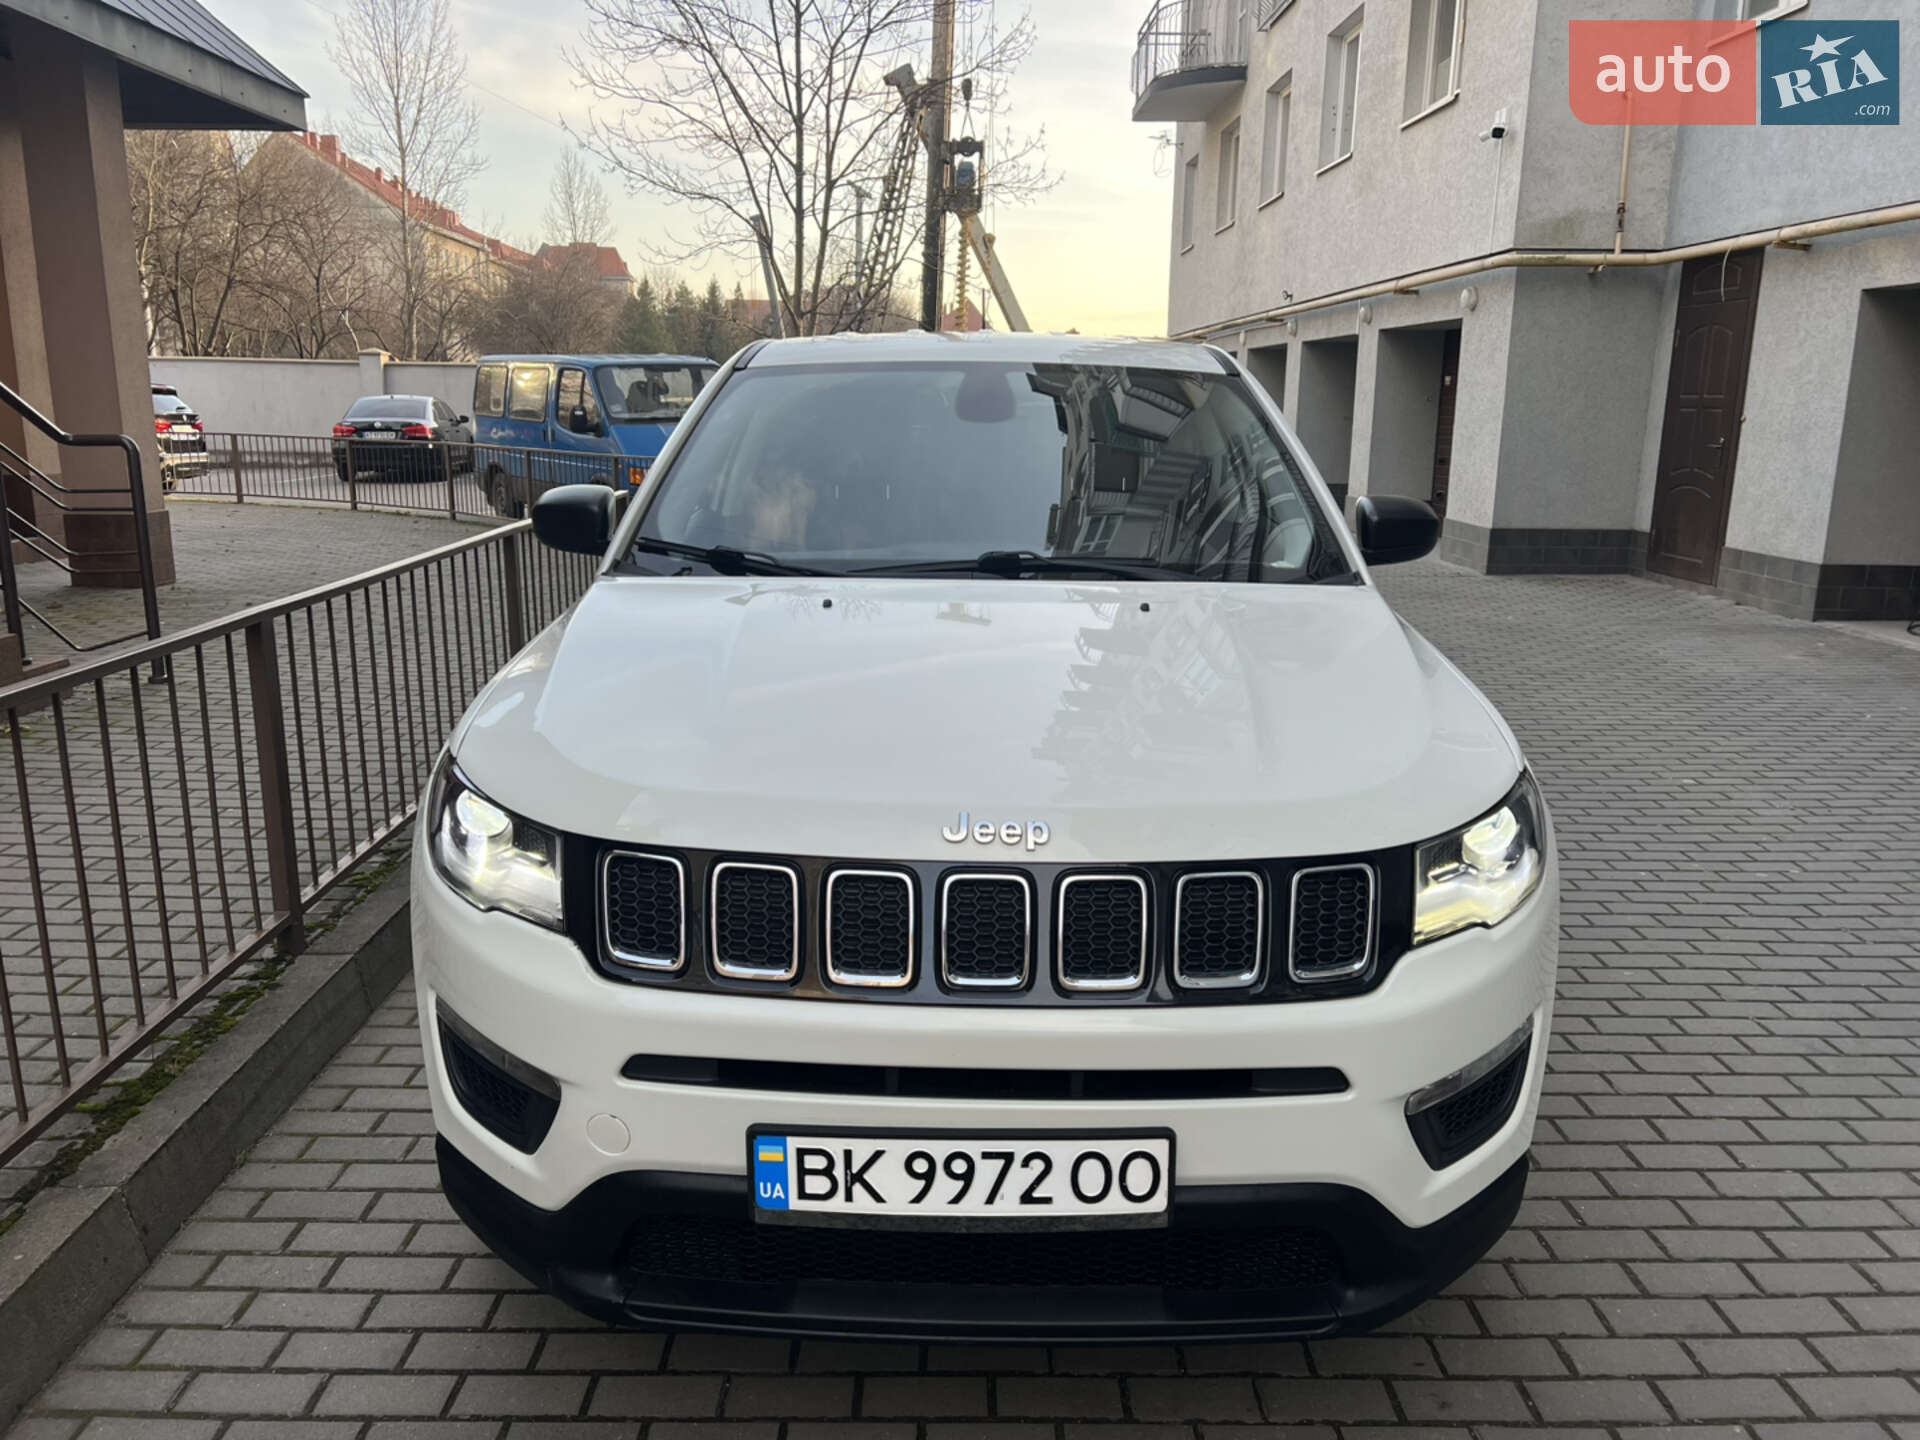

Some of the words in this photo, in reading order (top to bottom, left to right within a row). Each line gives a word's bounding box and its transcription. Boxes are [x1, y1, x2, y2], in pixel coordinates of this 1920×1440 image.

[942, 810, 1051, 852] Jeep
[759, 1182, 785, 1200] UA
[796, 1146, 888, 1204] BK
[904, 1150, 1054, 1206] 9972
[1070, 1150, 1161, 1204] OO
